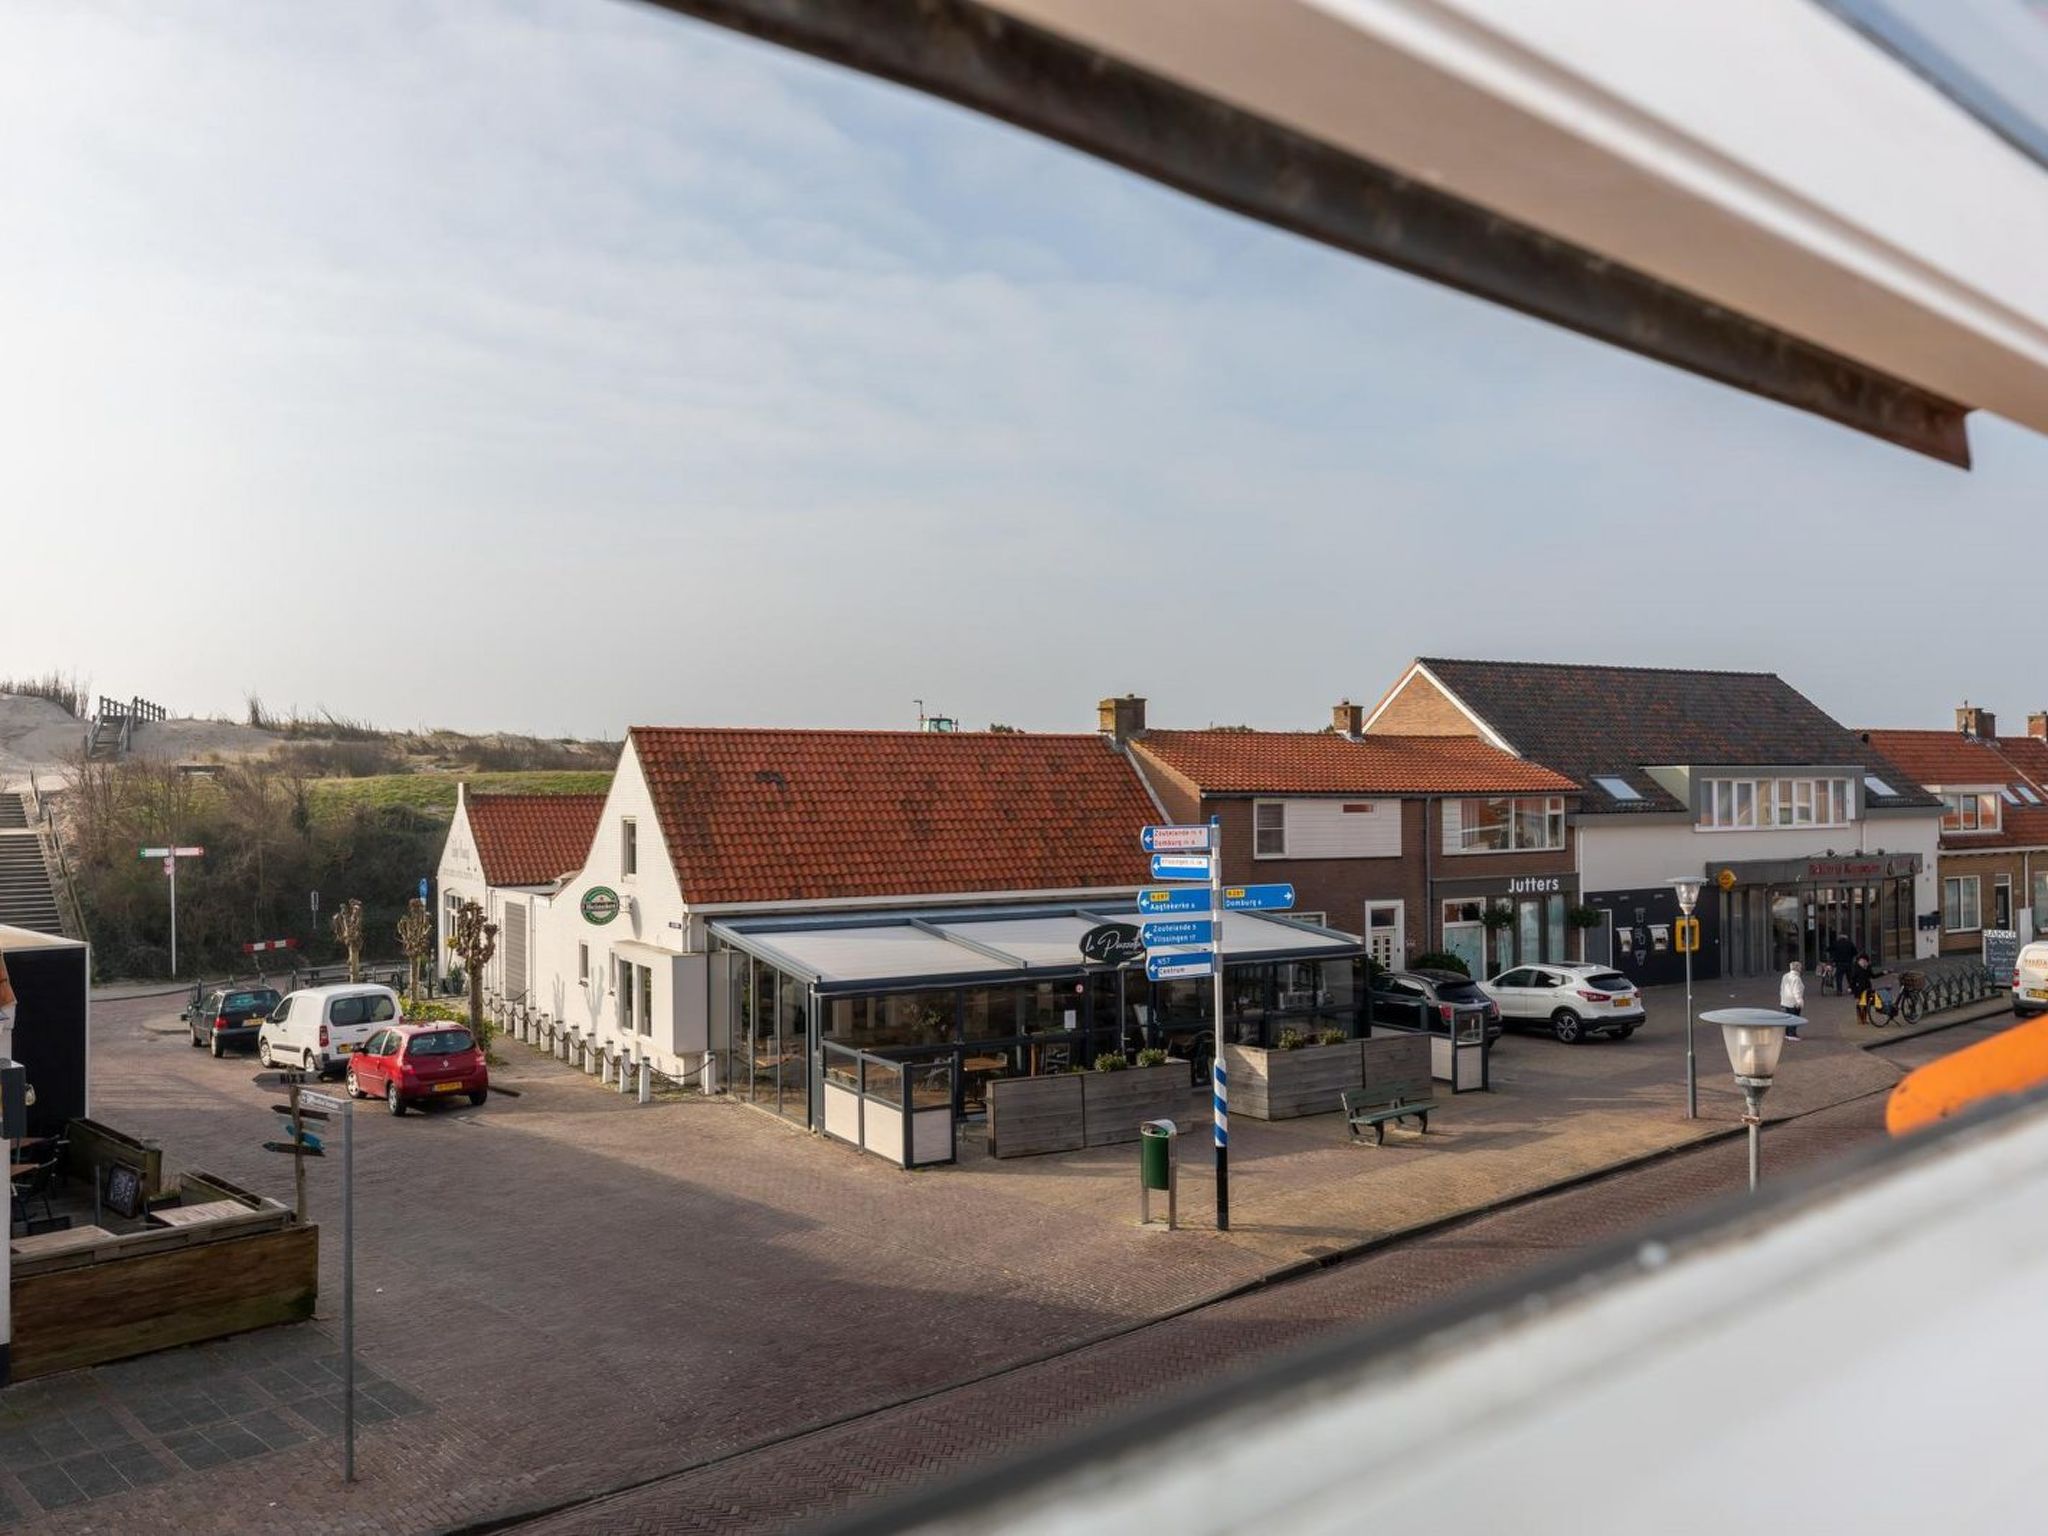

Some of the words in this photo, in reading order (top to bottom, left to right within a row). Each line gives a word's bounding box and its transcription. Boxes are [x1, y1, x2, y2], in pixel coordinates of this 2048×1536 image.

[1508, 877, 1560, 893] Jutters
[1226, 899, 1257, 908] Domburg
[1153, 924, 1190, 933] Zoutelande
[1153, 934, 1188, 943] Vlissingen
[1159, 966, 1185, 976] Centrum
